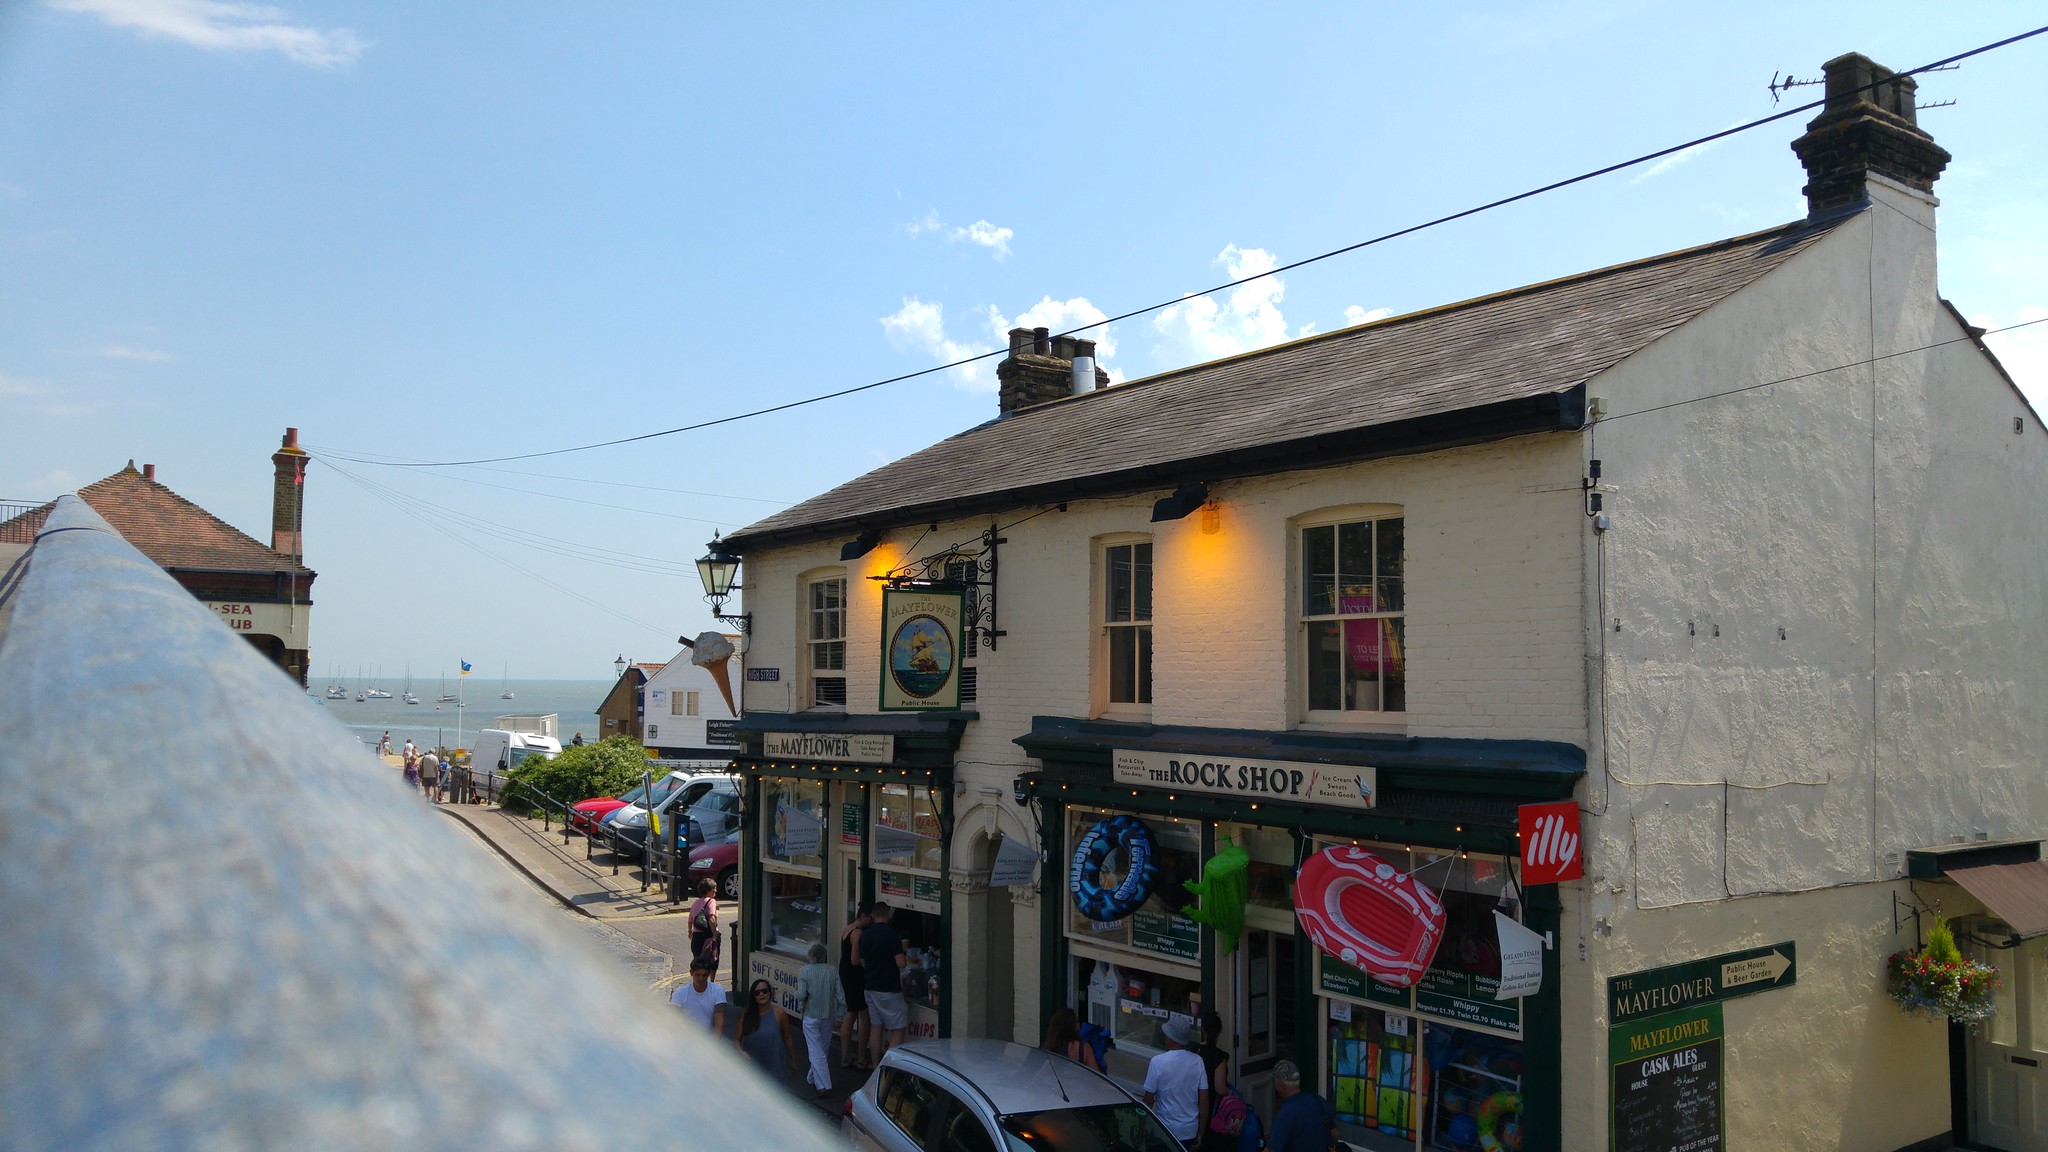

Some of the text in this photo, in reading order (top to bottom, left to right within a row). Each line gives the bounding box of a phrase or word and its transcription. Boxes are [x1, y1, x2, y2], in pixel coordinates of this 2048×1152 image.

[208, 604, 253, 615] -SEA
[890, 602, 958, 620] MAYFLOWER
[1356, 645, 1380, 653] TO LE
[749, 669, 778, 680] HIGH STREET
[768, 738, 850, 757] THE MAYFLOWER
[1149, 760, 1304, 795] THE ROCK SHOP
[1527, 814, 1578, 876] illy
[1070, 832, 1100, 892] Inferno
[1157, 937, 1175, 947] Whippy
[1503, 952, 1523, 960] GELATO
[752, 960, 771, 977] SOFT
[1727, 960, 1766, 974] Public House
[1323, 972, 1334, 980] Mint
[1348, 978, 1360, 986] Chip
[1437, 976, 1454, 985] Raisin
[1447, 970, 1465, 979] Ripple
[1504, 973, 1526, 982] Traditional
[1734, 975, 1748, 983] Beer
[1750, 969, 1772, 979] Garden
[1323, 980, 1350, 992] Strawberry
[1374, 984, 1400, 995] Chocolate
[1476, 984, 1495, 993] Lemon
[1615, 979, 1633, 991] THE
[1616, 977, 1714, 1017] MAYFLOWER
[1453, 1000, 1480, 1012] Whippy
[1417, 1002, 1438, 1012] Regular
[1440, 1008, 1455, 1016] £1.70
[1472, 1014, 1488, 1023] £2.70
[1490, 1018, 1507, 1027] Flake
[1508, 1022, 1520, 1030] 30p
[908, 1021, 935, 1038] CHIPS
[1630, 1018, 1710, 1053] MAYFLOWER
[1642, 1048, 1698, 1078] CASK ALES
[1692, 1062, 1707, 1072] GUEST
[1631, 1079, 1648, 1091] HOUSE
[1679, 1144, 1689, 1152] PUB
[1690, 1141, 1697, 1150] OF
[1697, 1138, 1706, 1147] THE
[1707, 1134, 1720, 1144] YEAR
